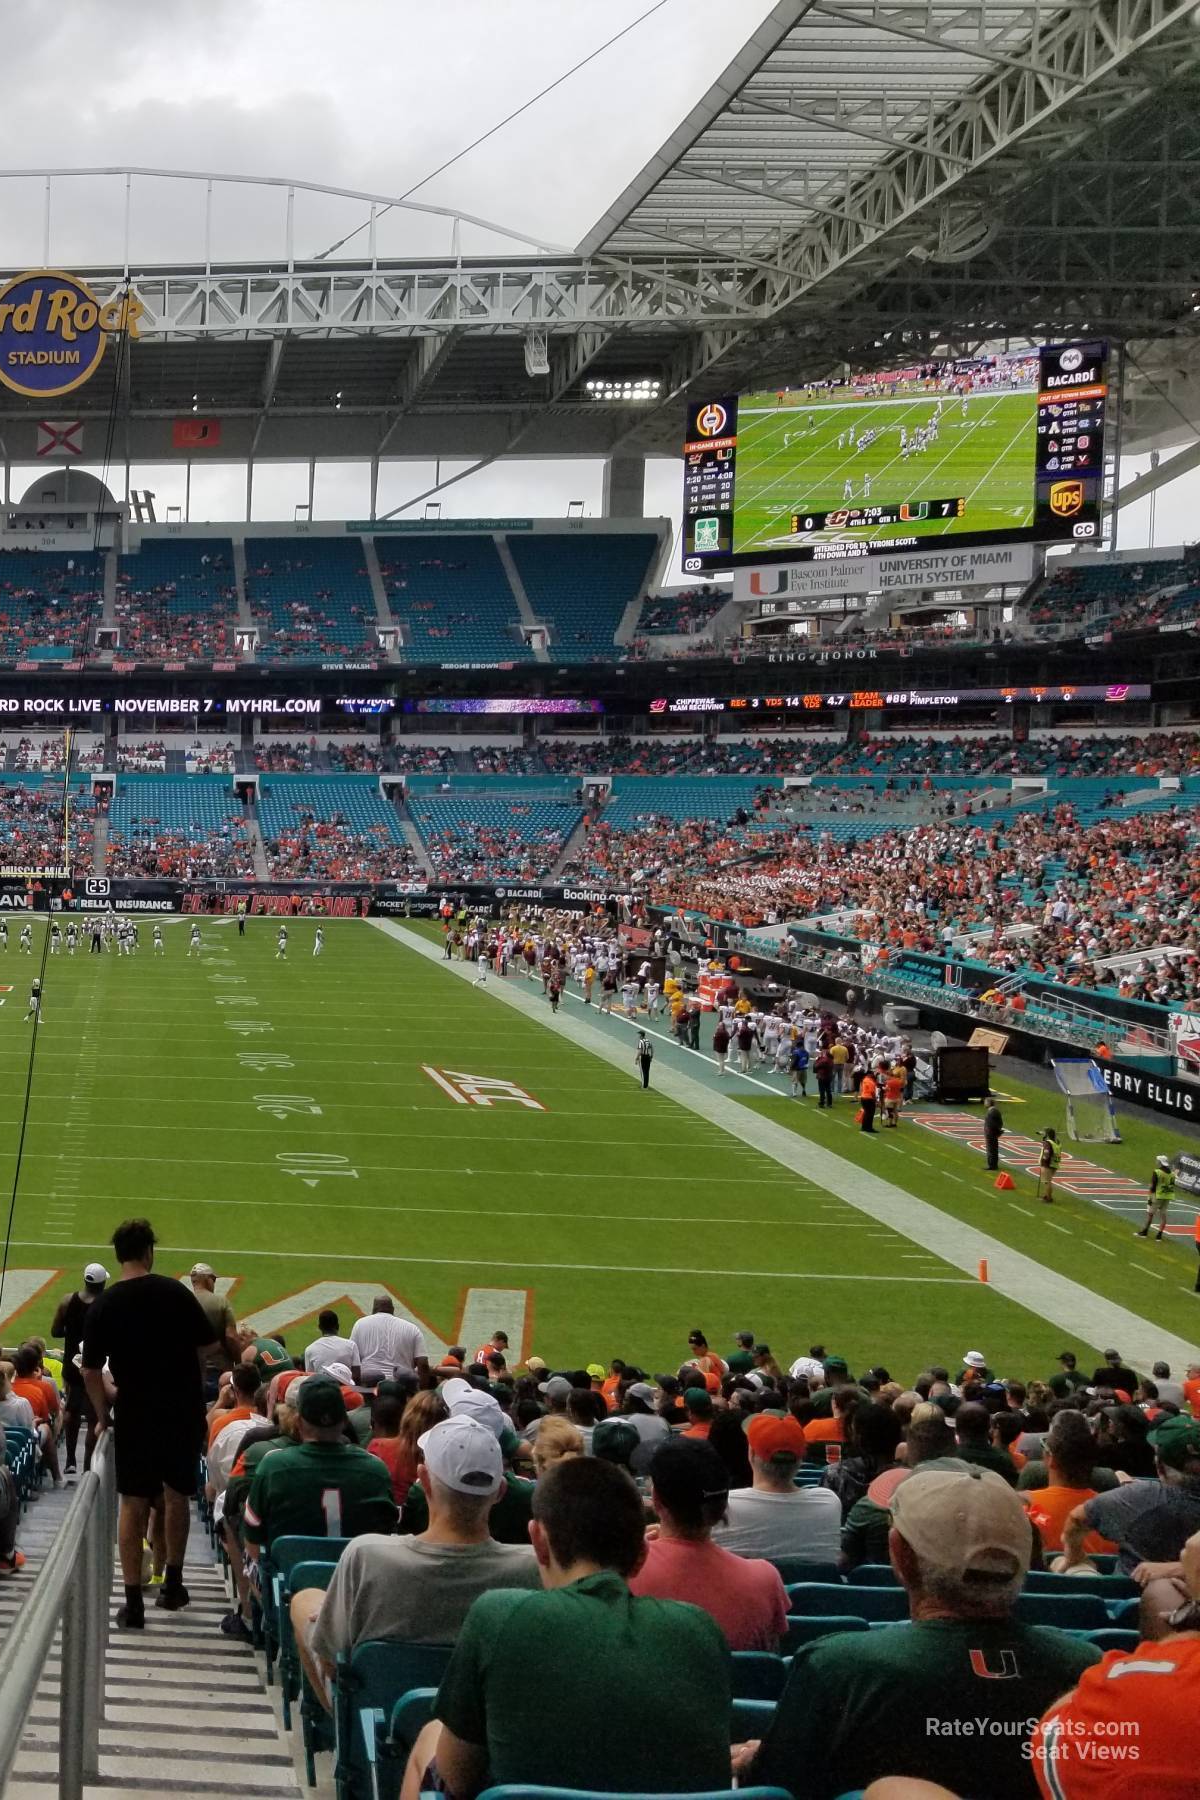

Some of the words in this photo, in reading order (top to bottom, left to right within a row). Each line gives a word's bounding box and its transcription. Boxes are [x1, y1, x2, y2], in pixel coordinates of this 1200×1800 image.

[47, 289, 144, 340] Rock
[8, 351, 80, 365] STADIUM
[1047, 368, 1096, 387] BACARDÍ
[1096, 401, 1102, 409] 7
[1040, 408, 1045, 417] 0
[1095, 419, 1101, 427] 7
[1038, 426, 1046, 434] 13
[1051, 489, 1081, 511] ups
[864, 507, 882, 517] 7:03
[941, 504, 950, 516] 7
[805, 518, 813, 529] 0
[1075, 524, 1092, 536] CC
[814, 545, 844, 553] INTENDED
[869, 540, 894, 548] TYRONE
[895, 538, 917, 546] SCOTT.
[879, 556, 950, 572] UNIVERSITY
[952, 555, 967, 567] OF
[970, 551, 1012, 565] MIAMI
[791, 567, 829, 580] Bascom
[831, 564, 864, 576] Palmer
[880, 572, 924, 587] HEALTH
[927, 569, 974, 583] SYSTEM
[791, 581, 808, 593] Eye
[809, 577, 849, 589] Institute
[768, 653, 806, 662] RING
[821, 650, 878, 660] HONOR
[752, 699, 758, 707] 3
[786, 698, 799, 706] 14
[827, 696, 844, 705] 4.7
[886, 694, 907, 703] #88
[24, 699, 64, 711] ROCK
[69, 699, 102, 711] LIVE
[115, 700, 198, 712] NOVEMBER
[204, 700, 212, 712] 7
[226, 699, 320, 713] MYHRL.COM
[1, 866, 42, 877] MUSCLE
[90, 879, 106, 893] 25
[506, 887, 542, 898] BACARDÍ
[116, 900, 173, 909] INSURANCE
[1148, 1083, 1193, 1111] ELLIS
[253, 1095, 322, 1115] 20
[276, 1152, 359, 1179] 10
[322, 1489, 342, 1538] 1
[968, 1649, 1018, 1679] U
